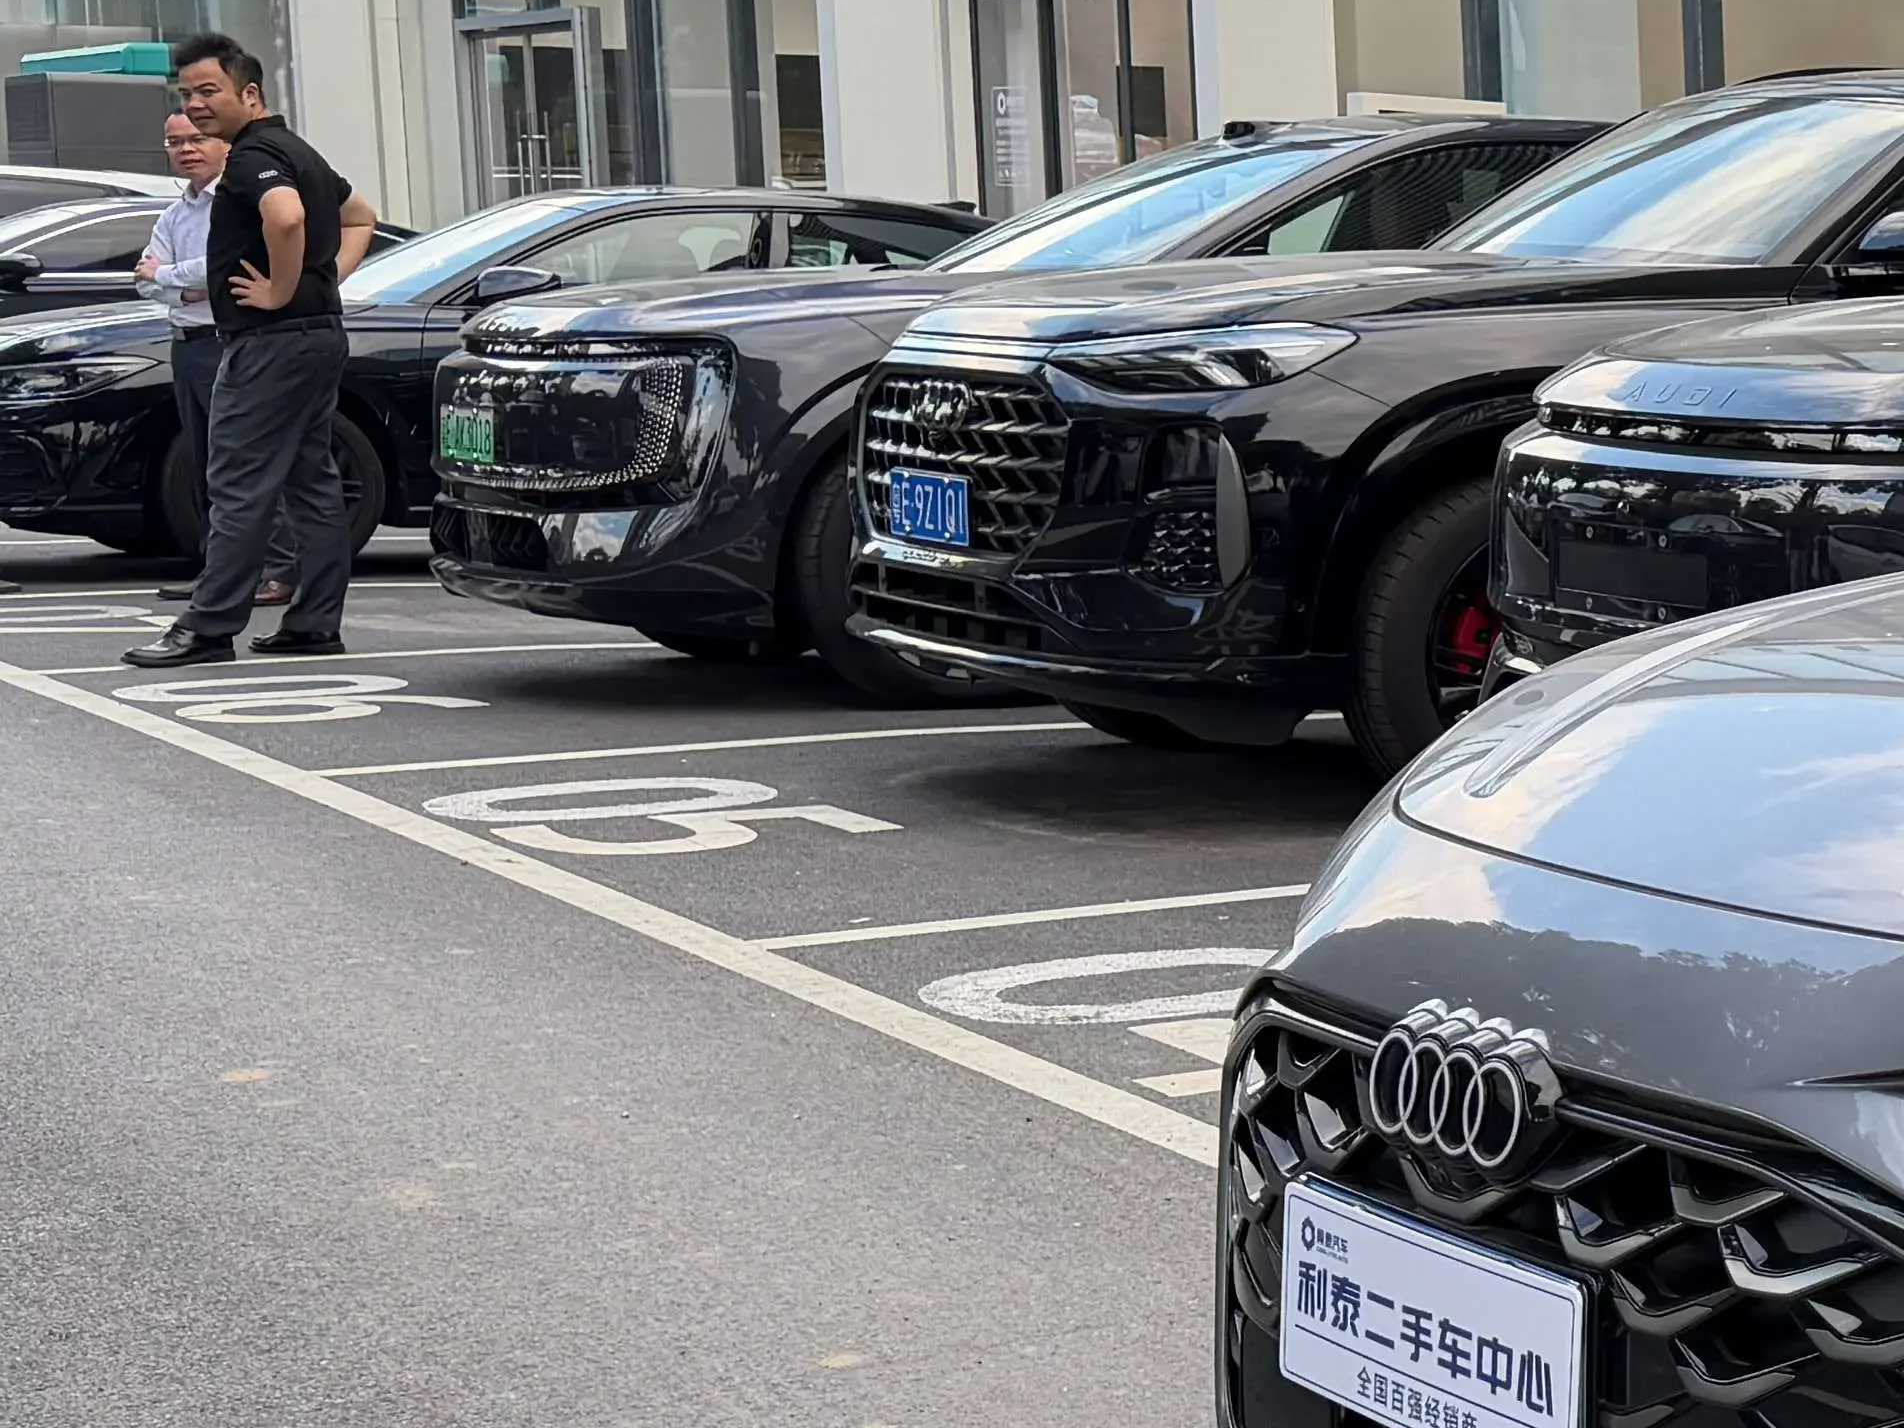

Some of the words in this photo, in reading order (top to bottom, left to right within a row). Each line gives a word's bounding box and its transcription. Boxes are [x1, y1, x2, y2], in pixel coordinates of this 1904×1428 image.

[1621, 379, 1739, 409] AUDI
[112, 674, 491, 723] 06
[421, 776, 904, 856] 05
[1297, 1260, 1554, 1418] 利泰二手车中心
